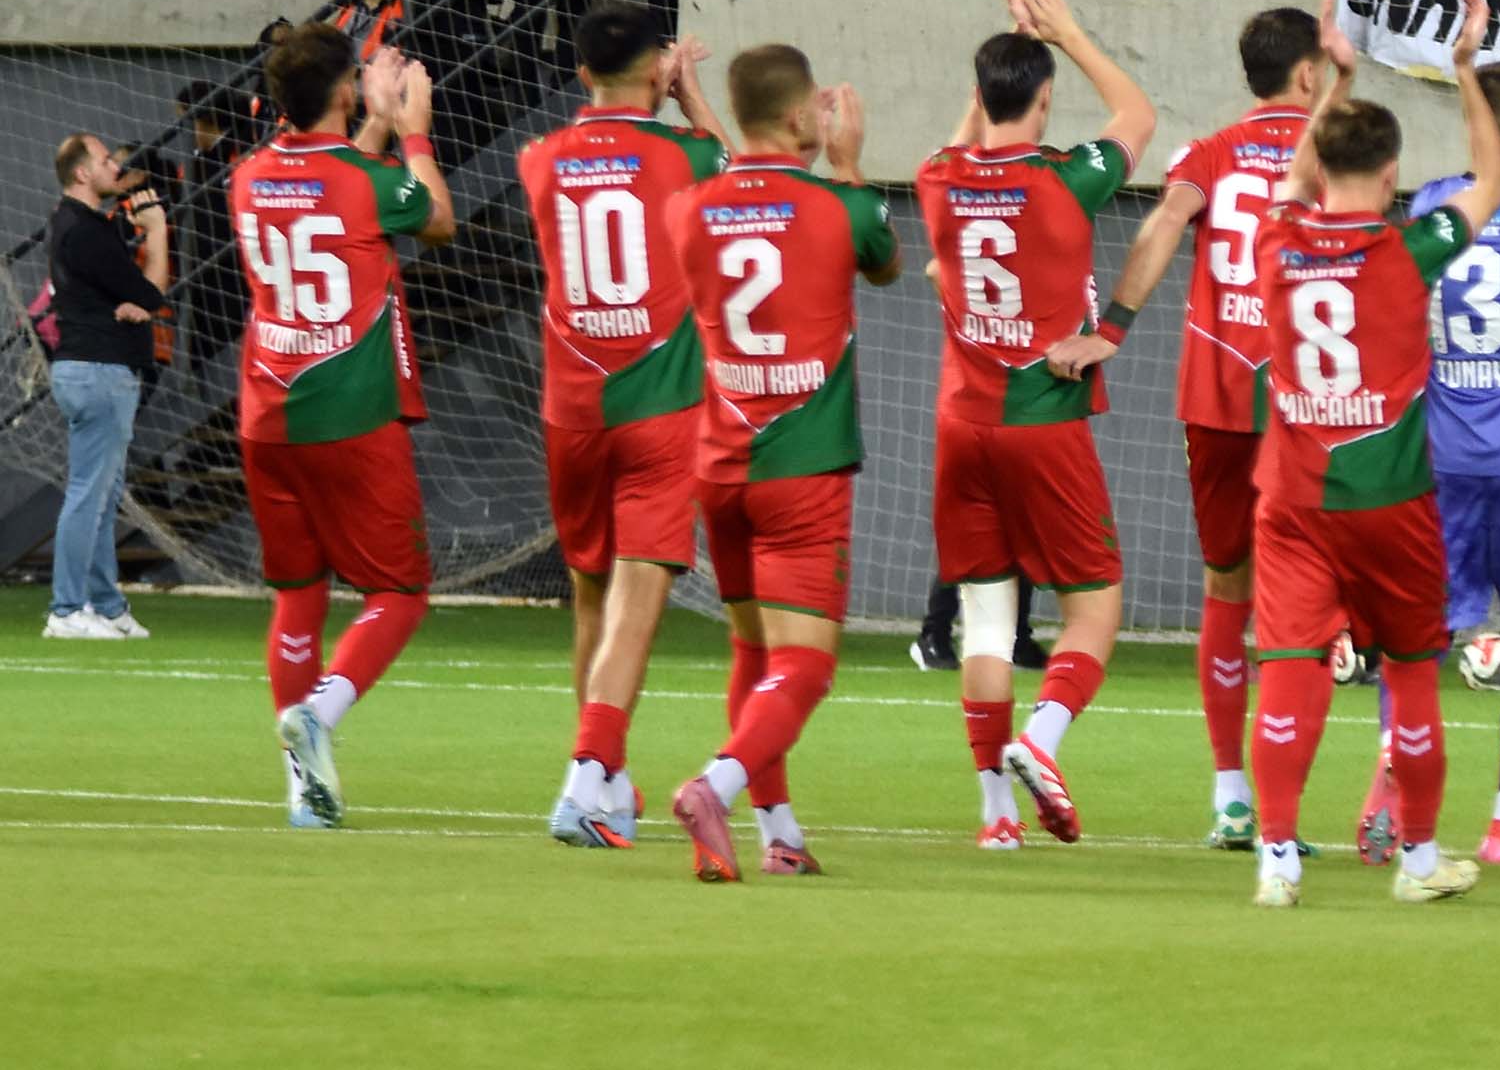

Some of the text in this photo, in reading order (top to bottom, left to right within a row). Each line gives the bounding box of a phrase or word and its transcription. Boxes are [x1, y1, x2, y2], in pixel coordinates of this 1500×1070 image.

[555, 155, 641, 174] TOLKAR
[251, 180, 324, 197] TOLKAR
[949, 187, 1027, 203] TOLKAR
[703, 203, 796, 222] TOLKAR
[556, 189, 651, 306] 10
[240, 212, 352, 323] 45
[961, 219, 1024, 318] 6
[720, 237, 787, 355] 2
[1221, 292, 1269, 327] ENS
[571, 307, 651, 338] ERHAN
[964, 313, 1034, 347] ALPAY
[1291, 279, 1362, 396] 8
[769, 359, 825, 395] KAYA
